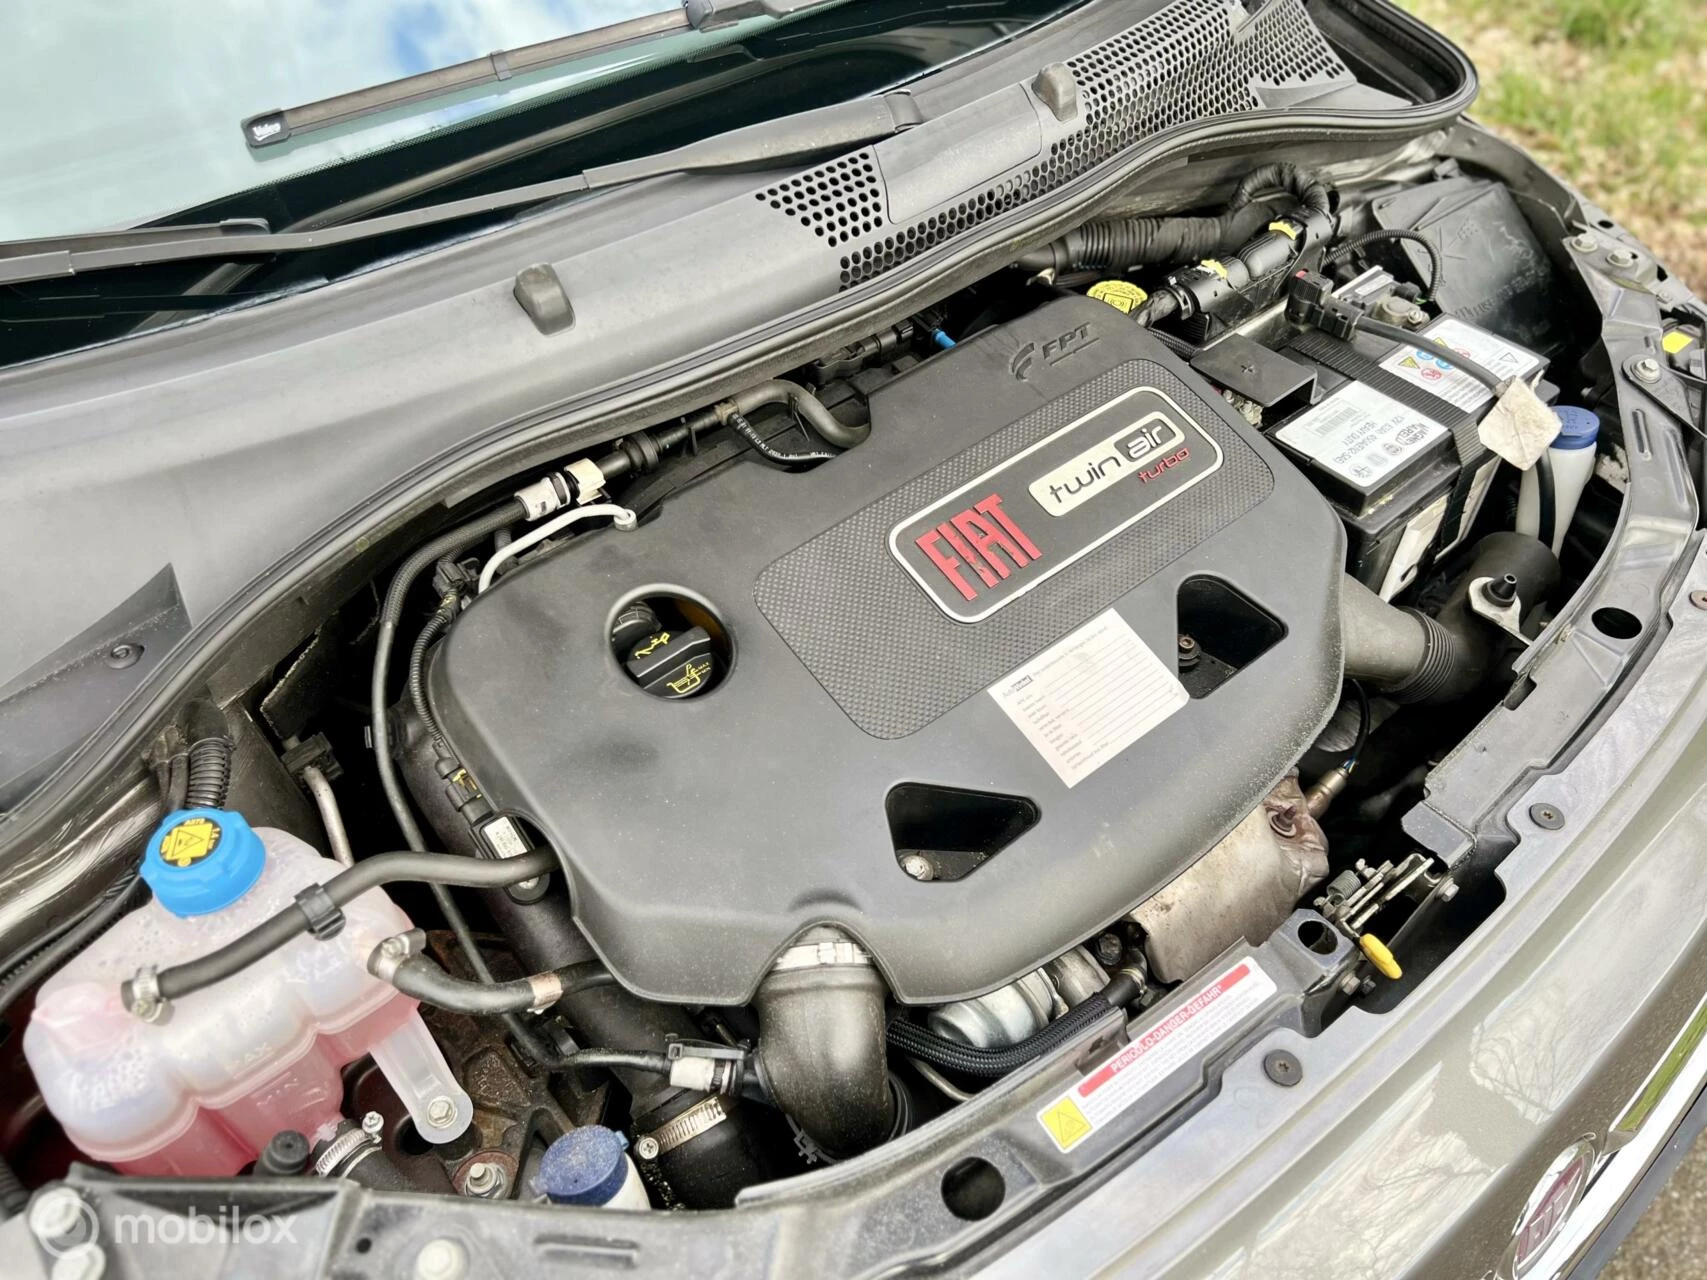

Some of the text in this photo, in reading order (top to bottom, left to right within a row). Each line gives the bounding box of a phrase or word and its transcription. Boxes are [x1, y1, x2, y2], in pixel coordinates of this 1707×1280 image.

[1042, 321, 1090, 360] FPT
[1049, 425, 1162, 503] twin air
[1138, 447, 1190, 483] turbo
[915, 493, 1042, 601] FIAT
